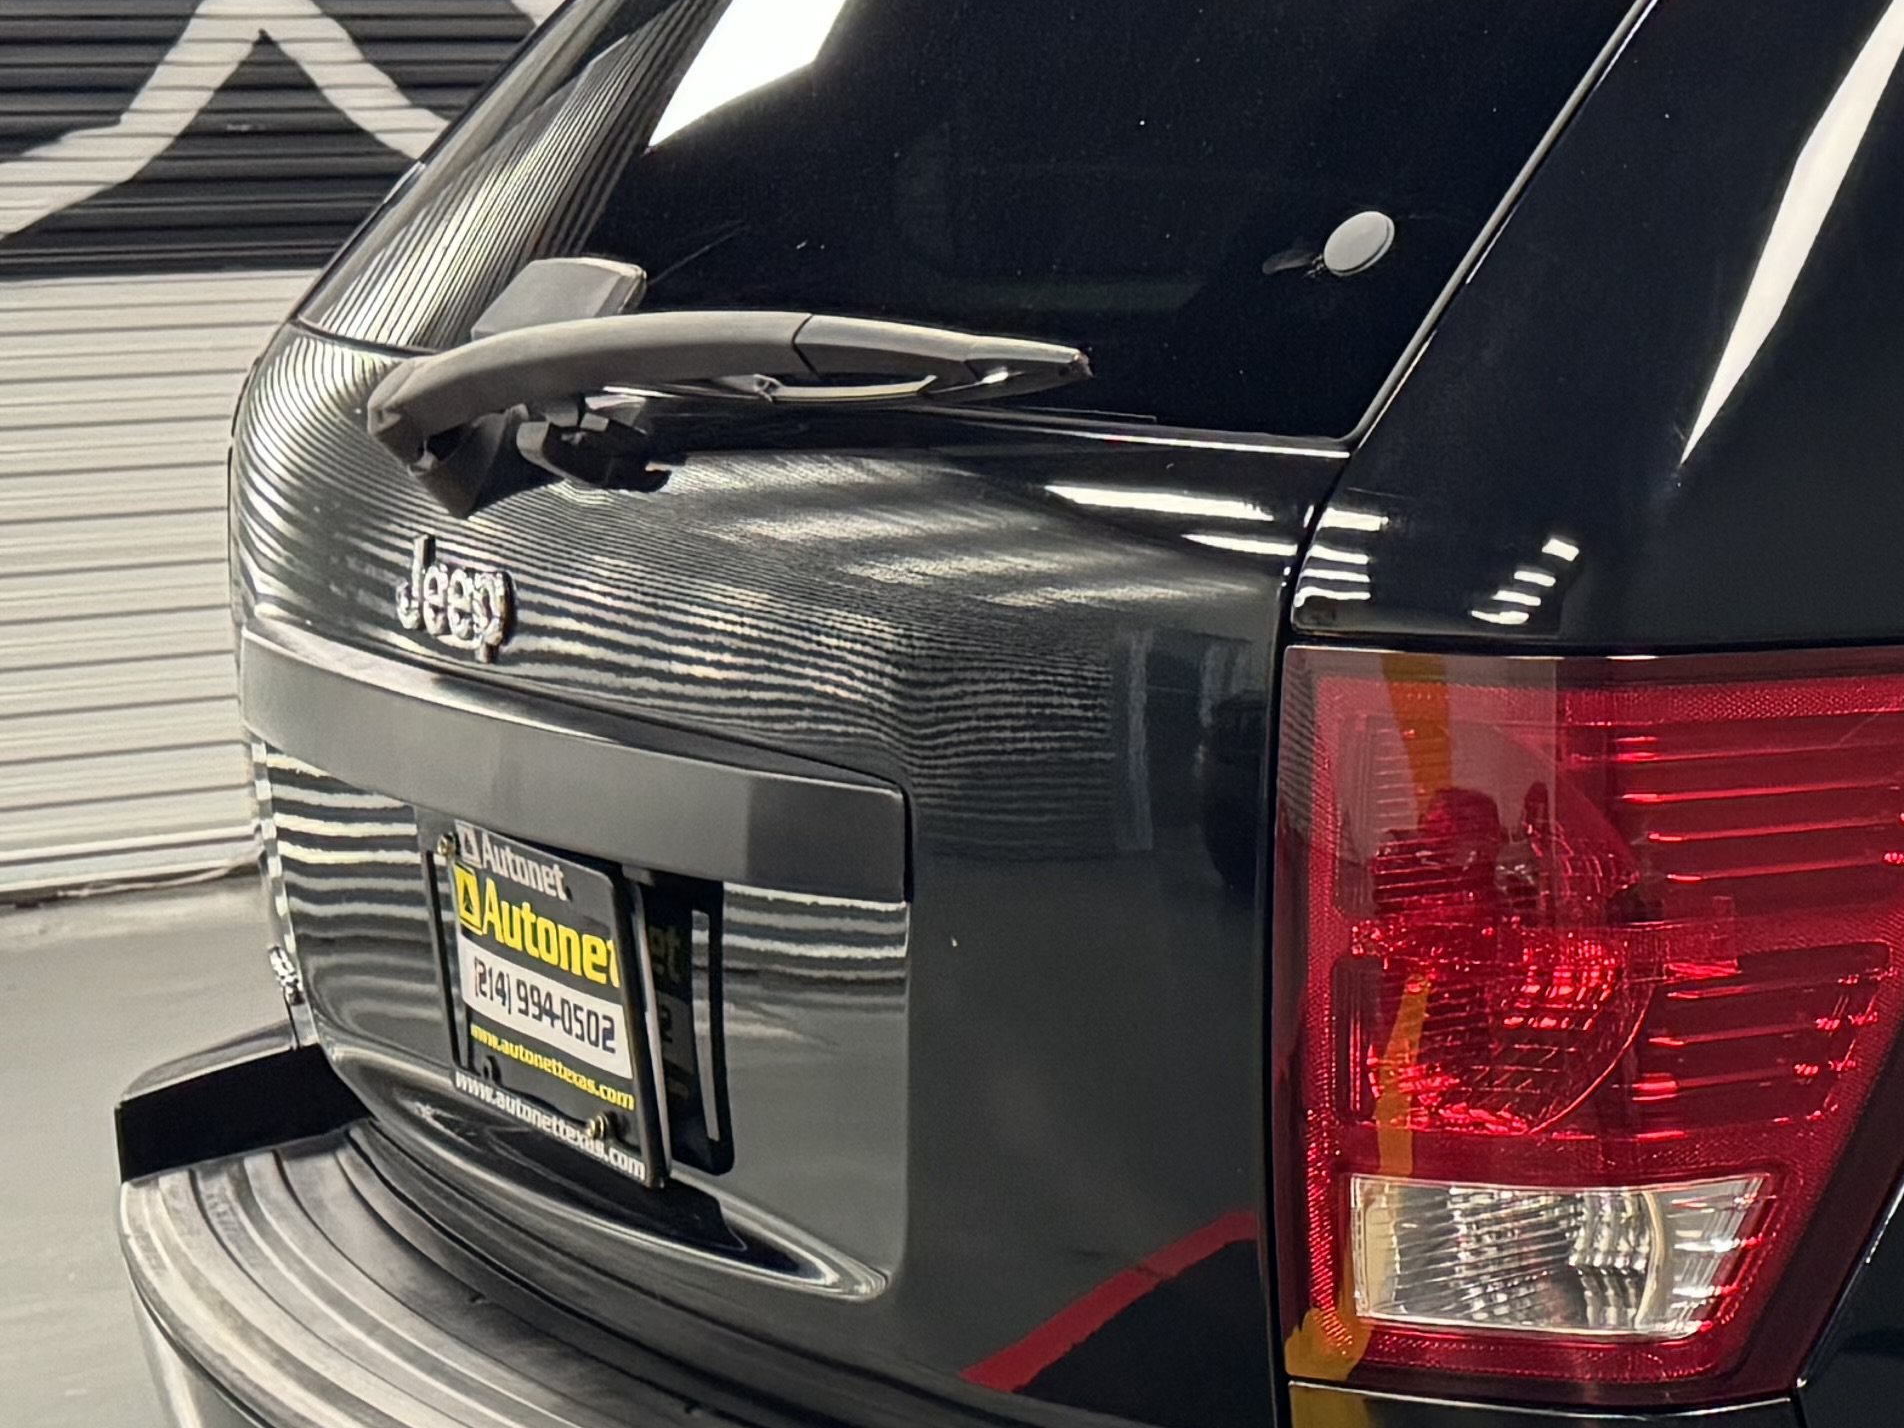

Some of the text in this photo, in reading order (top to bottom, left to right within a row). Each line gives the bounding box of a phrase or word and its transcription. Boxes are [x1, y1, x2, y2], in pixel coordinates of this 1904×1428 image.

[395, 534, 508, 664] Jeep
[481, 831, 569, 902] Autonet
[482, 876, 621, 989] Autonet
[515, 977, 617, 1055] 994-0502
